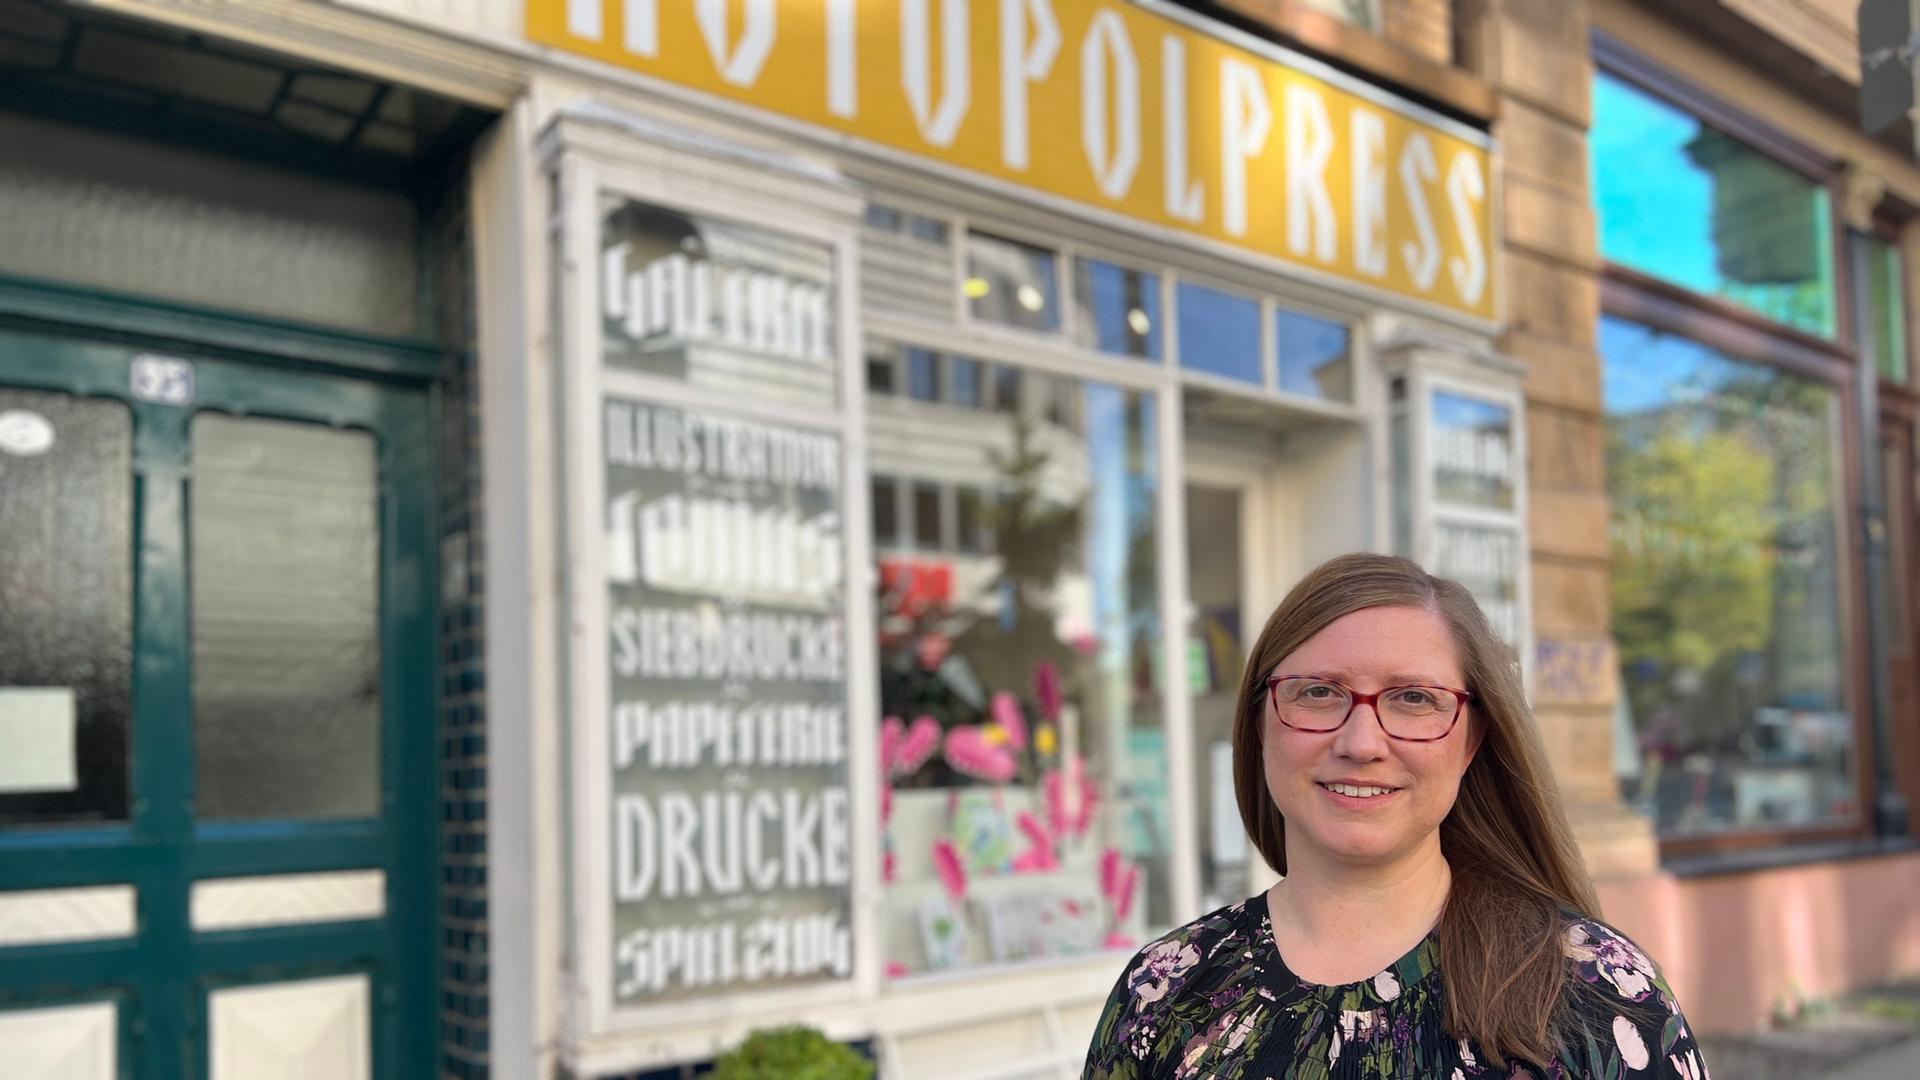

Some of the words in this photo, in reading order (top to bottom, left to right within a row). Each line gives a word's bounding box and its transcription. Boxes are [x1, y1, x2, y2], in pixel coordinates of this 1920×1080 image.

[566, 0, 1490, 307] OPOLPRESS
[606, 400, 840, 491] ILLUSTRATION
[612, 606, 845, 682] SIEBDRUCKE
[614, 698, 846, 770] PAPETERIE
[615, 786, 850, 902] DRUCKE
